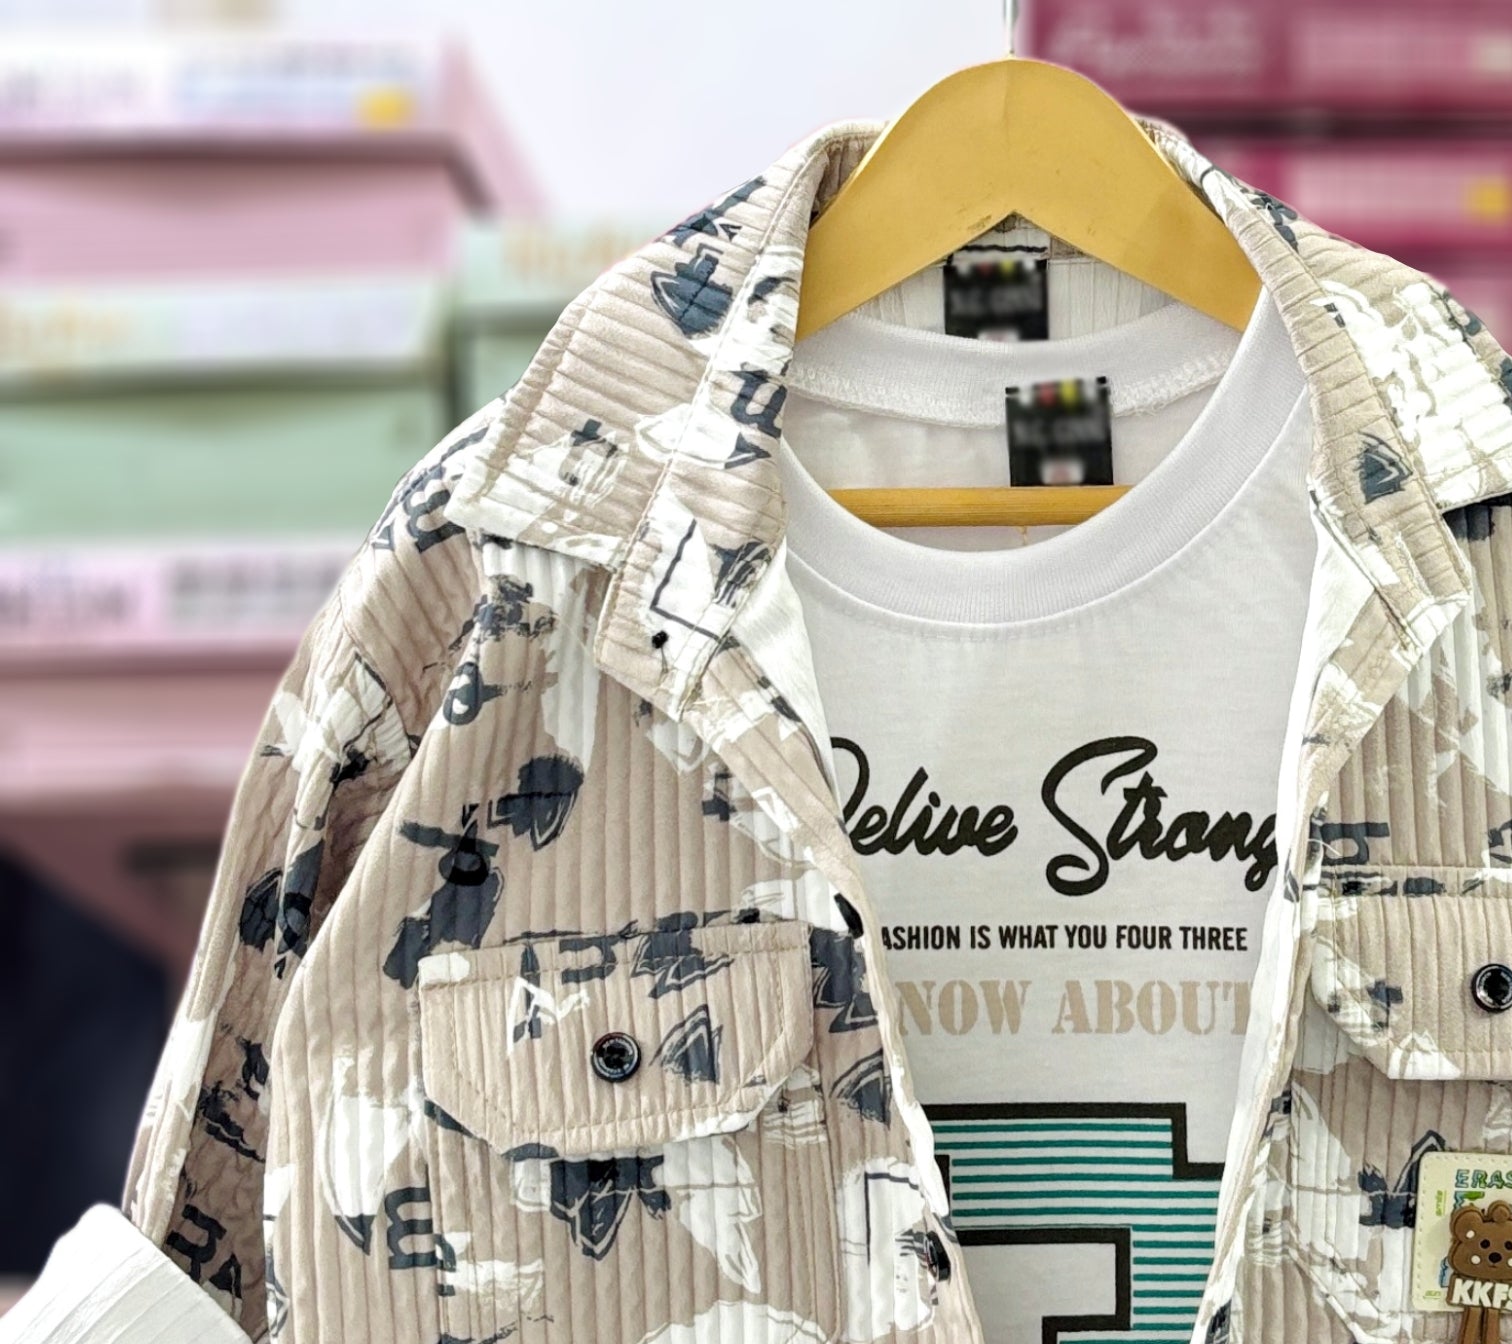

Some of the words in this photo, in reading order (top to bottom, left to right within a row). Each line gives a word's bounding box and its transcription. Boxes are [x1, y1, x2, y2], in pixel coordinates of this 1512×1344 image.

[1041, 735, 1279, 897] Strong
[970, 925, 991, 950] IS
[999, 925, 1058, 950] WHAT
[1064, 925, 1107, 950] YOU
[1116, 926, 1172, 951] FOUR
[1179, 926, 1248, 951] THREE
[895, 979, 1032, 1036] NOW
